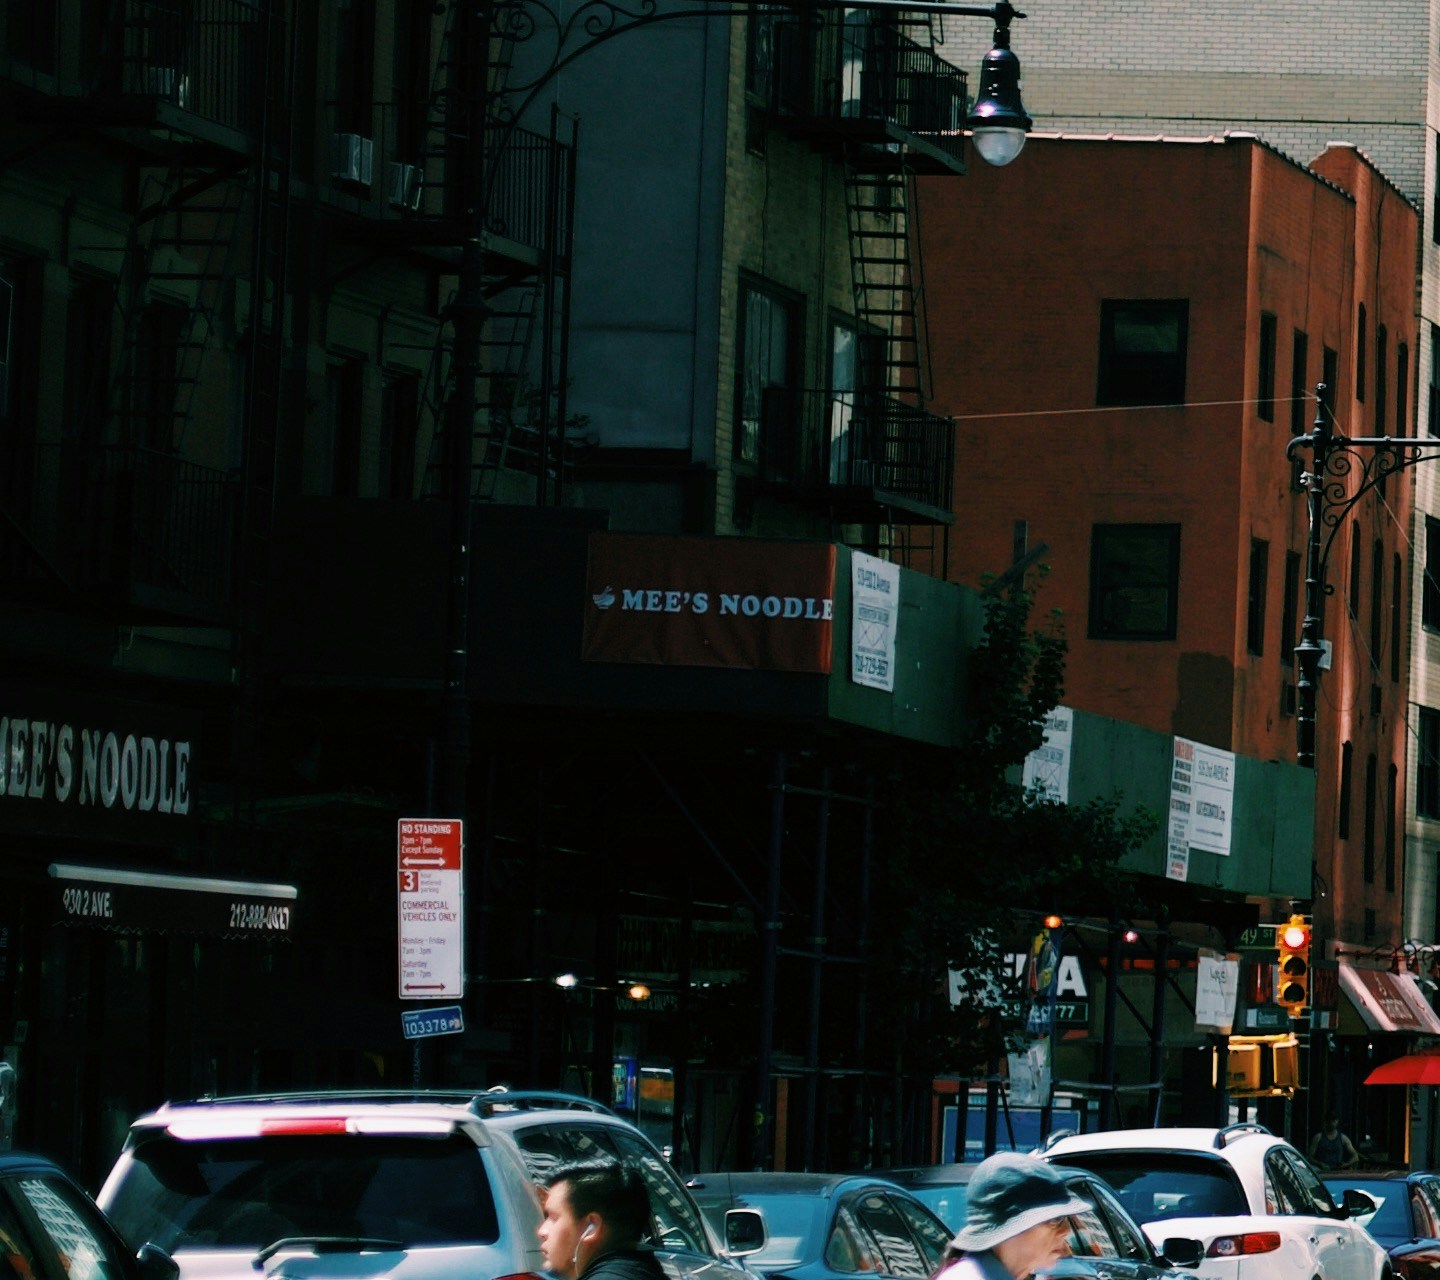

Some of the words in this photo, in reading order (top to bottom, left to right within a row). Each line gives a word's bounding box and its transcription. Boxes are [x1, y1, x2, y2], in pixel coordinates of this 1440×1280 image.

[621, 588, 711, 615] MEE'S
[719, 593, 833, 621] NOODLE
[78, 727, 191, 816] NOODLE
[401, 823, 414, 834] NO
[414, 823, 452, 835] STANDING
[403, 870, 415, 892] 3
[402, 900, 449, 910] COMMERCIAL
[402, 912, 436, 921] VEHICLES
[438, 912, 457, 921] ONLY
[405, 1017, 448, 1035] 103378
